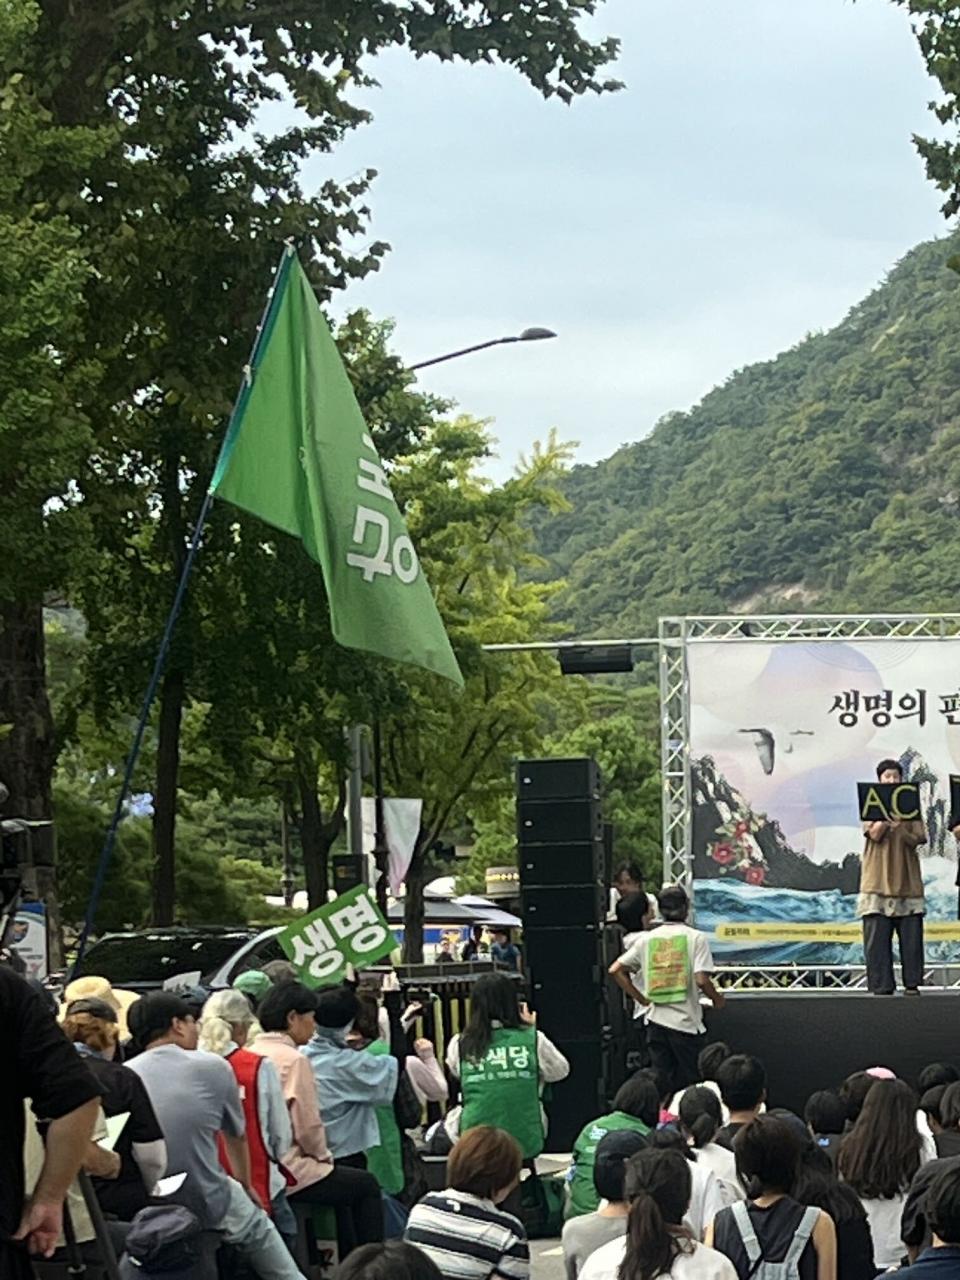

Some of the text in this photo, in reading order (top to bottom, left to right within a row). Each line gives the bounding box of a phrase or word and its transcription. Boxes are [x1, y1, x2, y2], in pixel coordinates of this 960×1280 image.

[828, 688, 927, 728] 생명의
[290, 893, 388, 978] 생명
[467, 1045, 530, 1071] 색당
